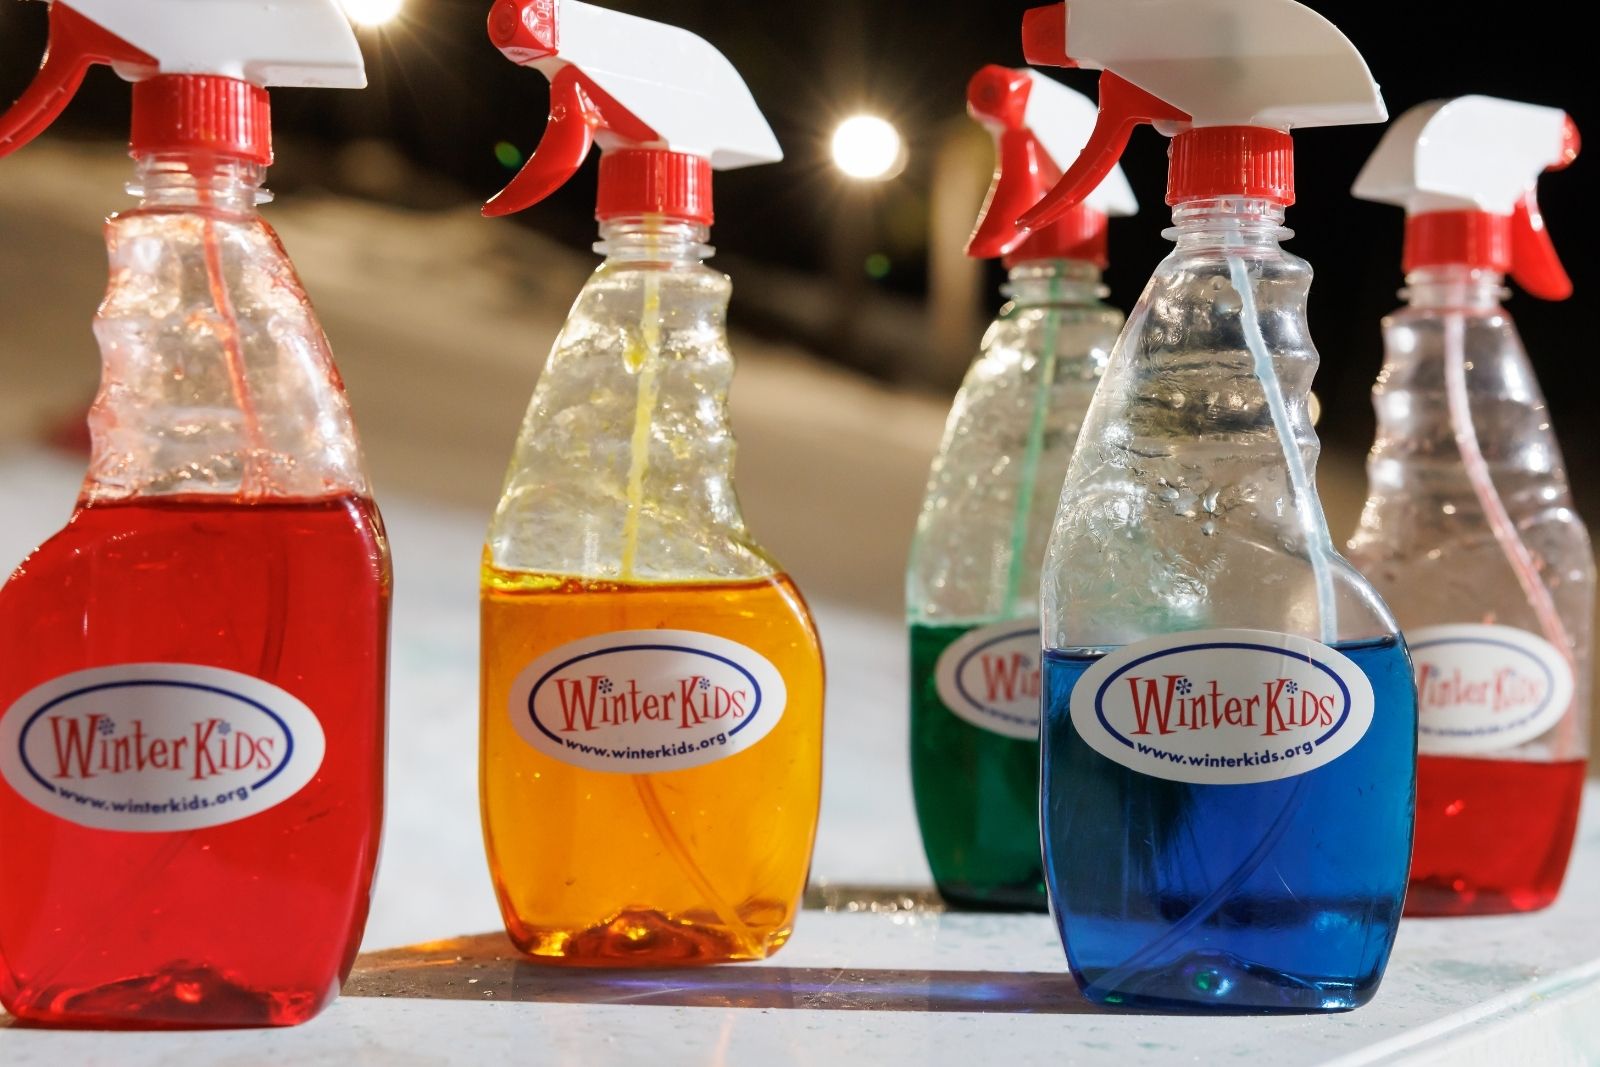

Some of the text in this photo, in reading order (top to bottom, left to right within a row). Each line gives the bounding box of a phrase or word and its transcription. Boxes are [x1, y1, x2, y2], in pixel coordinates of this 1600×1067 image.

[566, 731, 727, 760] www.winterkids.org
[1137, 741, 1313, 768] www.winterkids.org
[58, 786, 249, 814] www.winterkids.org
